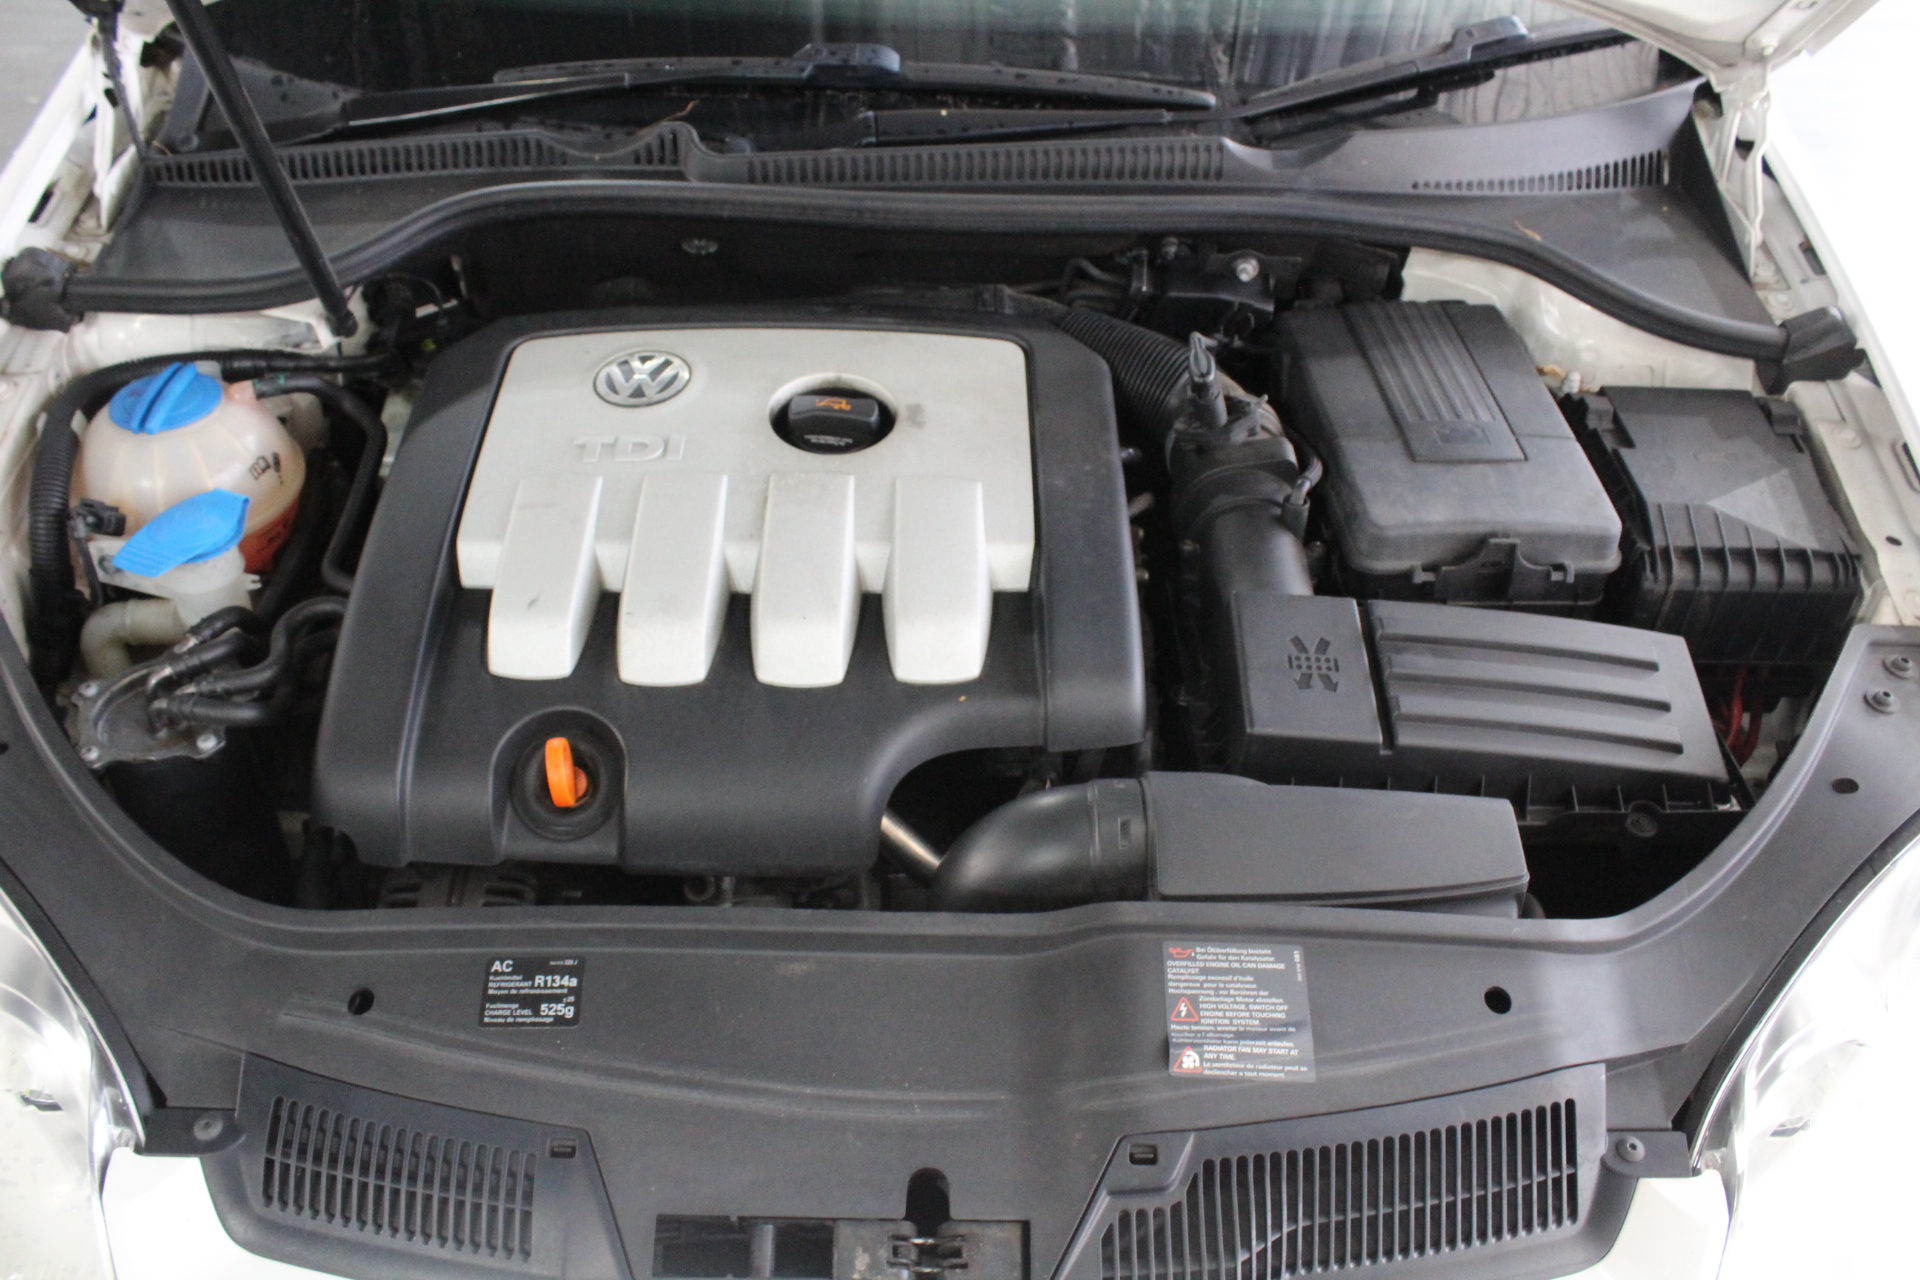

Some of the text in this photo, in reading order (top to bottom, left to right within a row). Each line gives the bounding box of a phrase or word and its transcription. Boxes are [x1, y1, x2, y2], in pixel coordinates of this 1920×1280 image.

[569, 435, 686, 463] TDI
[491, 960, 513, 972] AC
[534, 975, 578, 987] R134a
[540, 1004, 574, 1018] 525g
